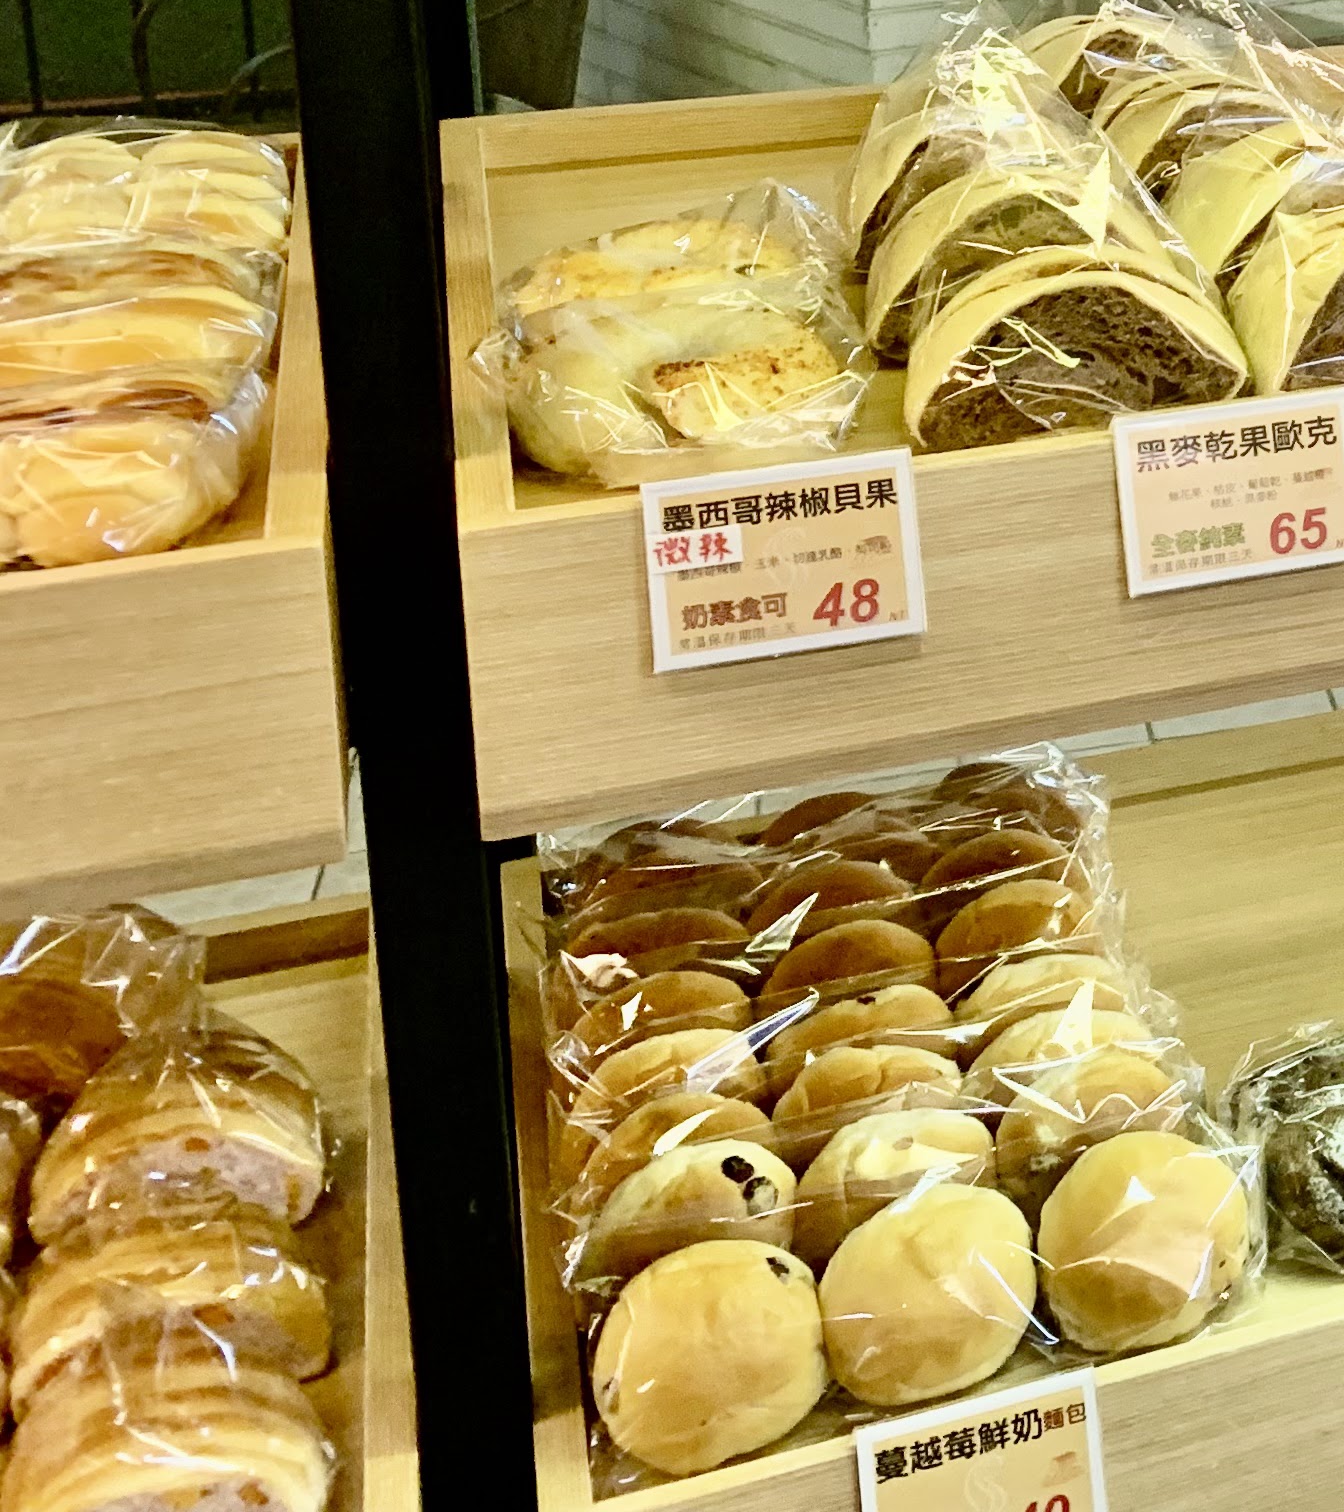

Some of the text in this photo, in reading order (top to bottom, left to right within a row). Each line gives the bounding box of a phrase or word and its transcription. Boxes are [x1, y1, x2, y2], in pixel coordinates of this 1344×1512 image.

[1136, 415, 1338, 473] 黑麥乾果歐克
[663, 478, 897, 532] 墨西哥辣椒貝果
[653, 532, 733, 567] 微辣
[1270, 507, 1327, 555] 65
[682, 592, 788, 631] 奶素食可
[813, 578, 879, 627] 48
